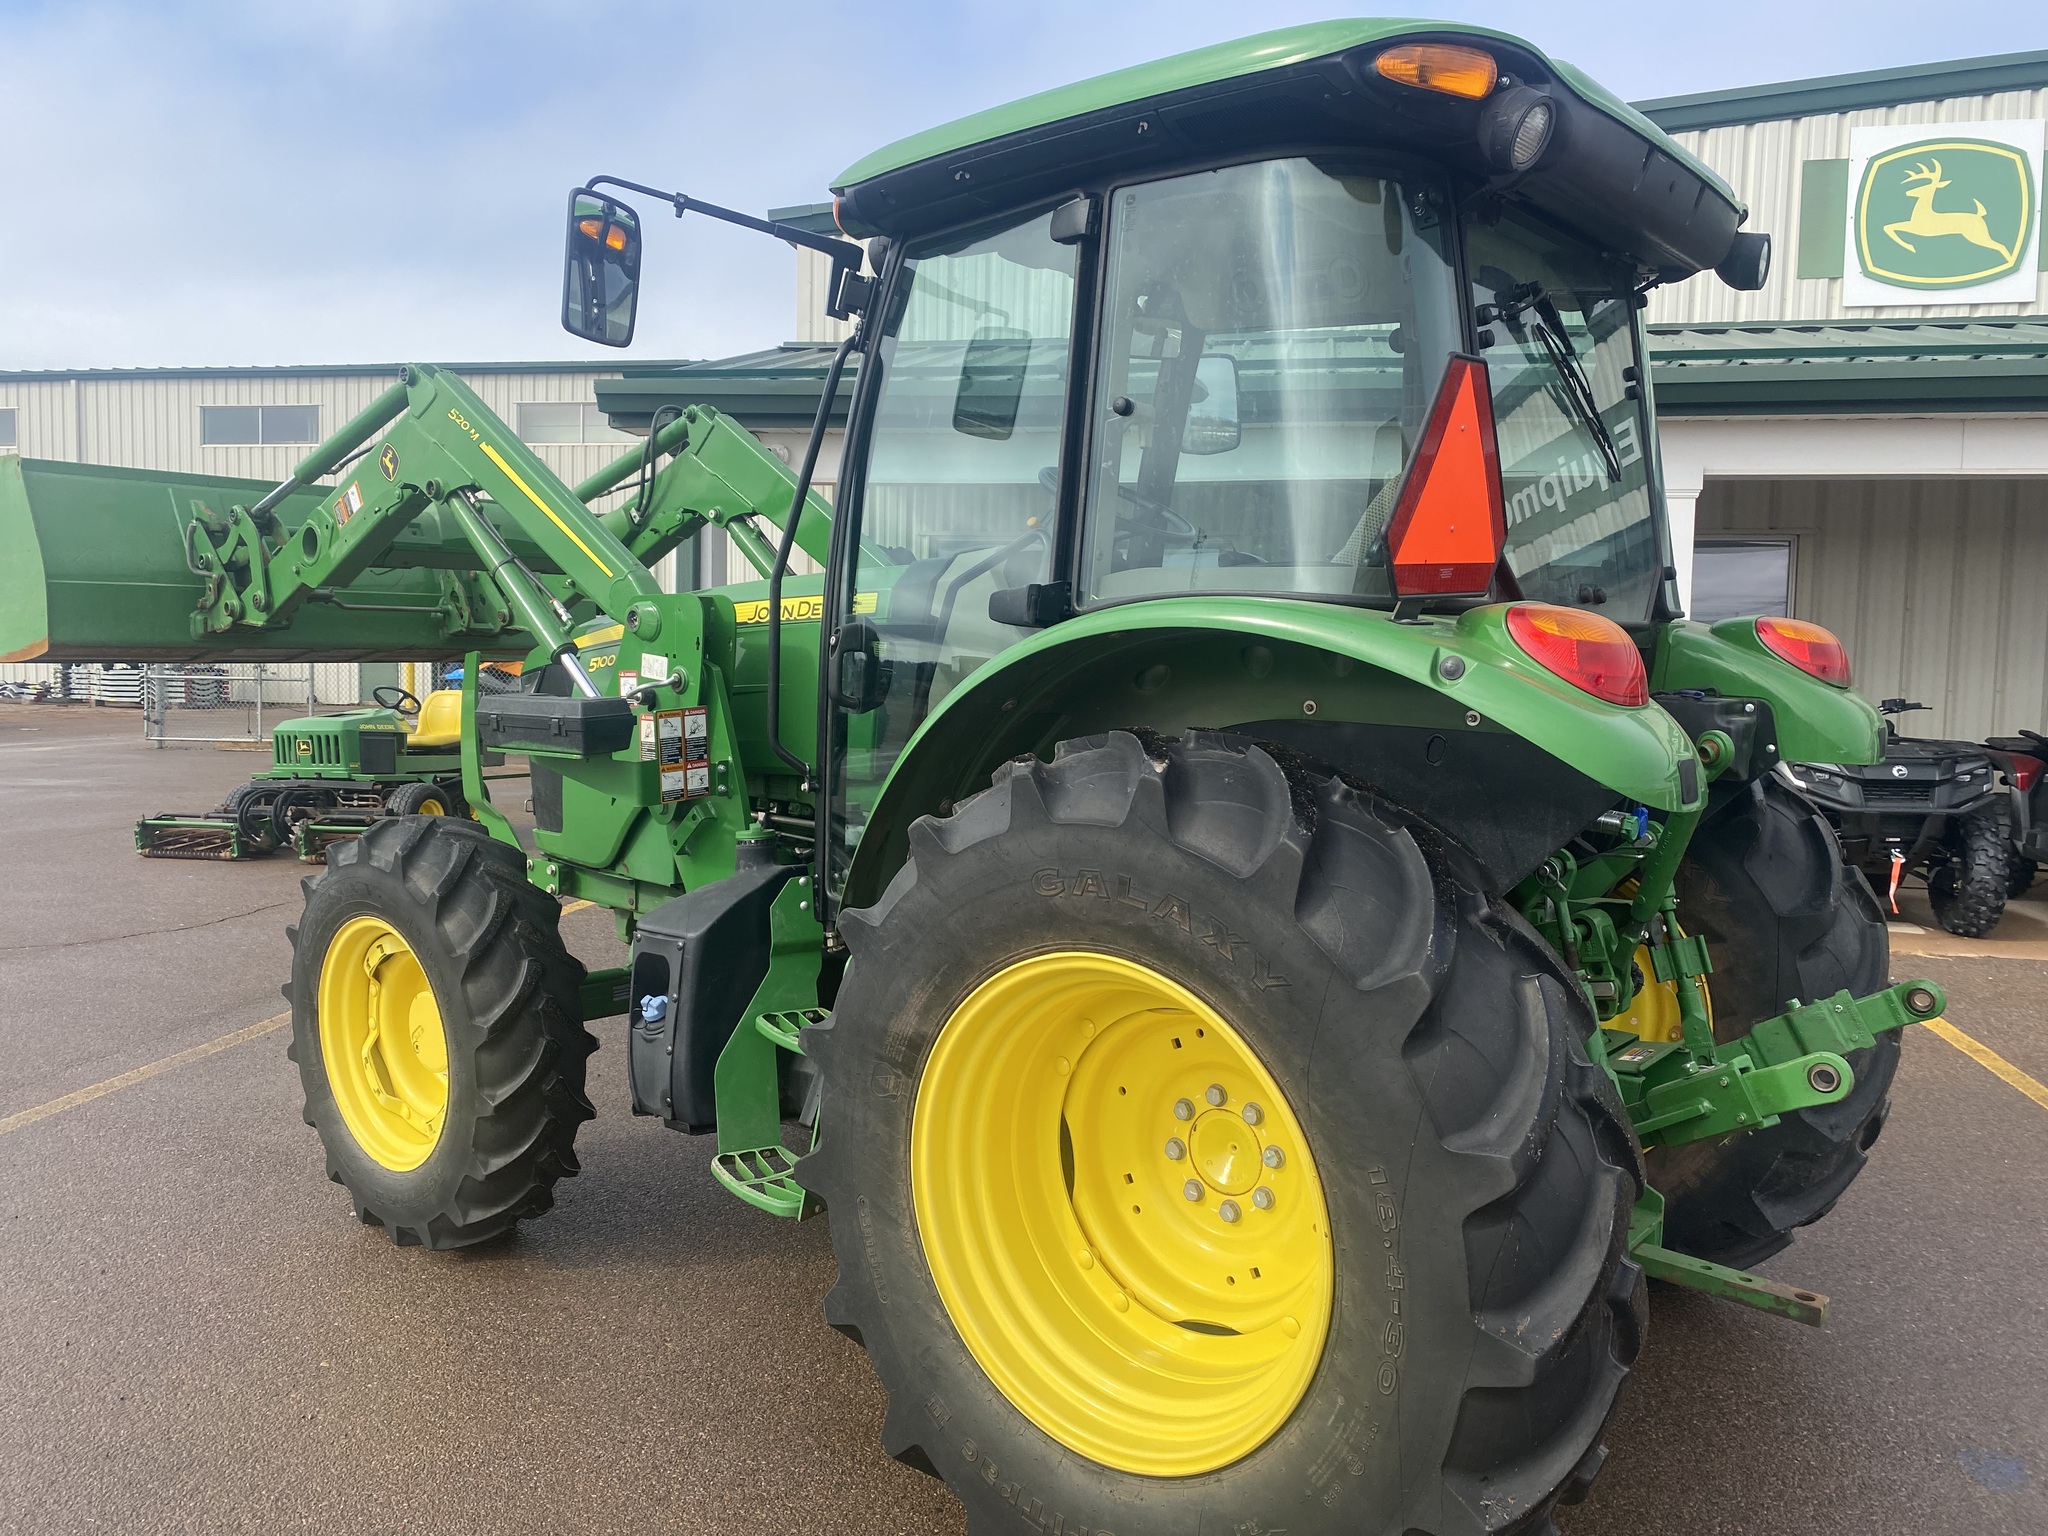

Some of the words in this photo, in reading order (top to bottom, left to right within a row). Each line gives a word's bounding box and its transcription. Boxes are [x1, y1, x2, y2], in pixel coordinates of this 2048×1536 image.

[748, 604, 794, 622] JON
[589, 653, 616, 673] 5100
[1031, 867, 1292, 993] GALAXY
[1367, 1165, 1406, 1396] 18.4-30
